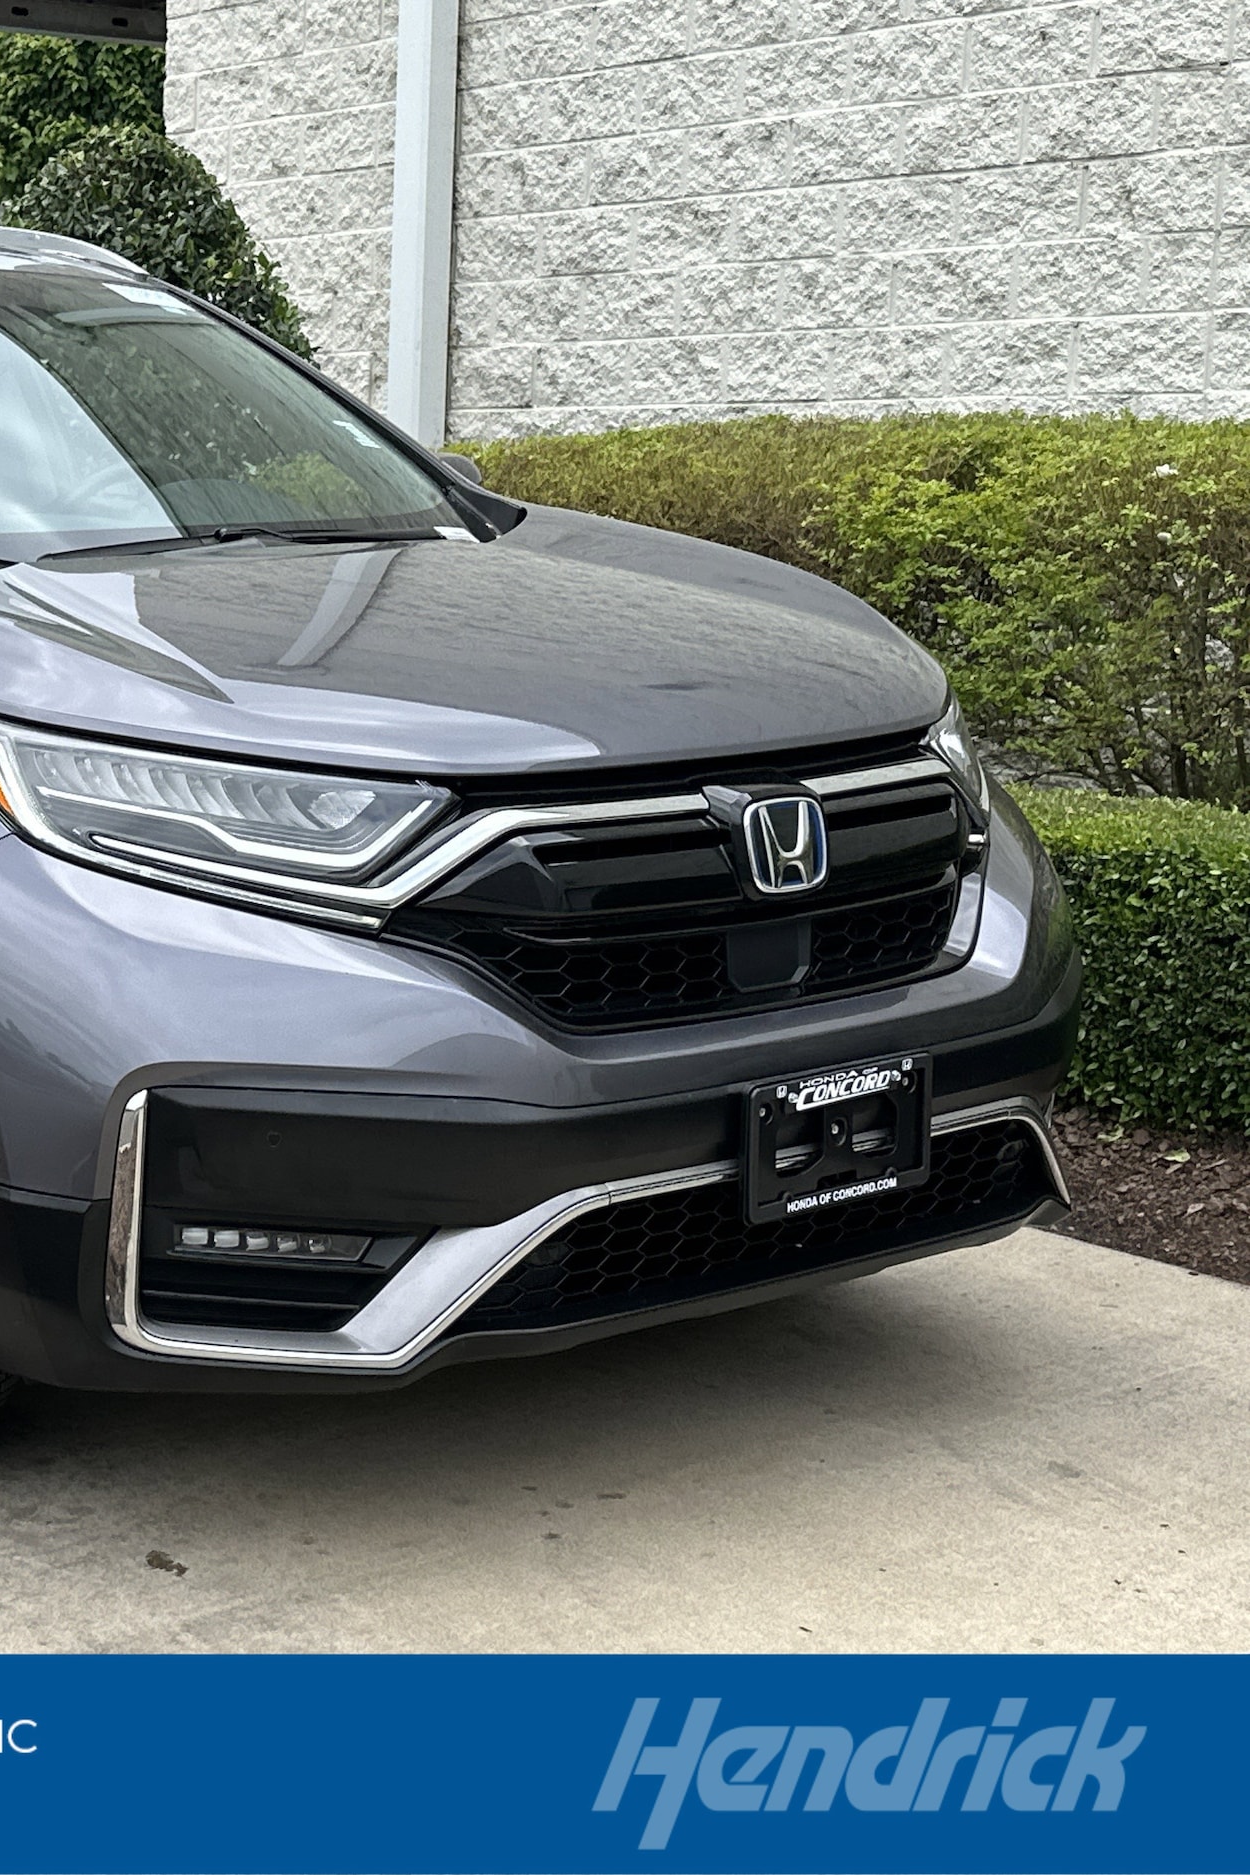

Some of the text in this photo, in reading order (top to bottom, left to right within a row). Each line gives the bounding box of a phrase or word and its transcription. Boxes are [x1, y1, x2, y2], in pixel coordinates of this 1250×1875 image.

[796, 1070, 891, 1111] CONCORD
[799, 1070, 859, 1089] HONDA
[786, 1177, 897, 1213] HONDA OF CONCORD.COM
